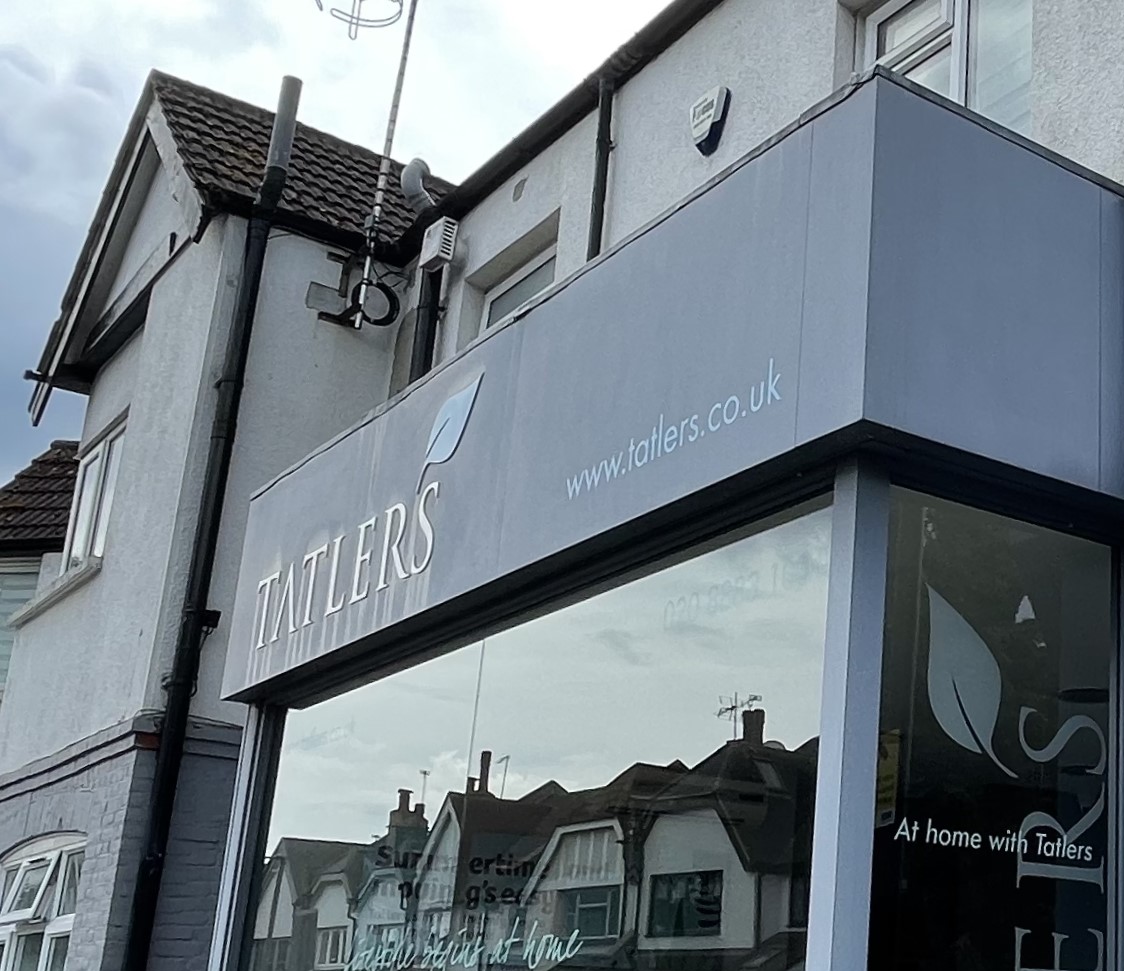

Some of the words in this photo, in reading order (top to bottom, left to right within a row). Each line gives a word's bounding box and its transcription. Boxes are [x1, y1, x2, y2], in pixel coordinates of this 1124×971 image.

[564, 357, 783, 500] www.tatlers.co.uk
[255, 480, 441, 651] TATLERS
[893, 816, 920, 843] At
[924, 818, 982, 850] home
[988, 829, 1029, 855] with
[1034, 832, 1093, 862] Tatlers
